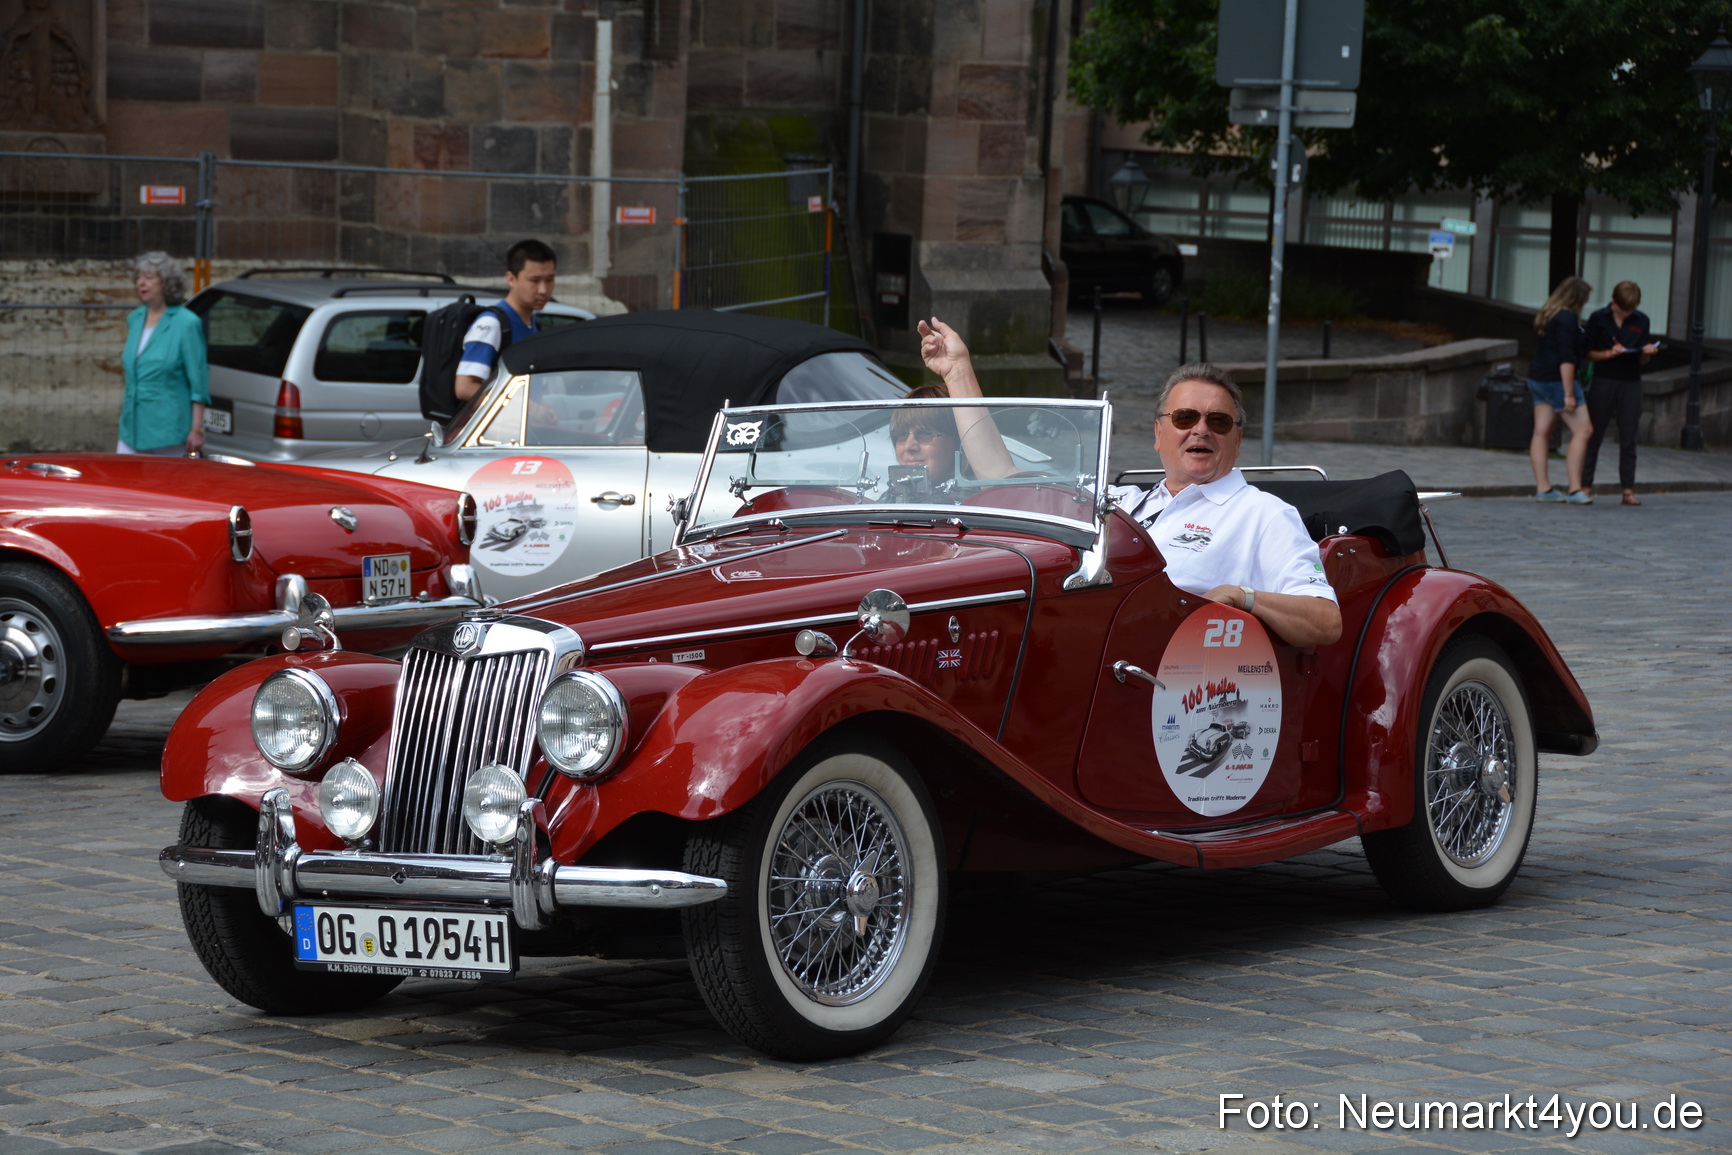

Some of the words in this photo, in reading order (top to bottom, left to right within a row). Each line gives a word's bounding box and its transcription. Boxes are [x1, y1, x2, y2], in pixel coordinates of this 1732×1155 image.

[511, 460, 543, 475] 13
[483, 496, 502, 513] 100
[373, 558, 389, 577] ND
[1203, 618, 1245, 648] 28
[1182, 684, 1203, 715] 100
[1205, 677, 1237, 702] Meilen
[317, 911, 357, 955] OG
[303, 938, 311, 950] D
[376, 966, 414, 976] SEELBACH
